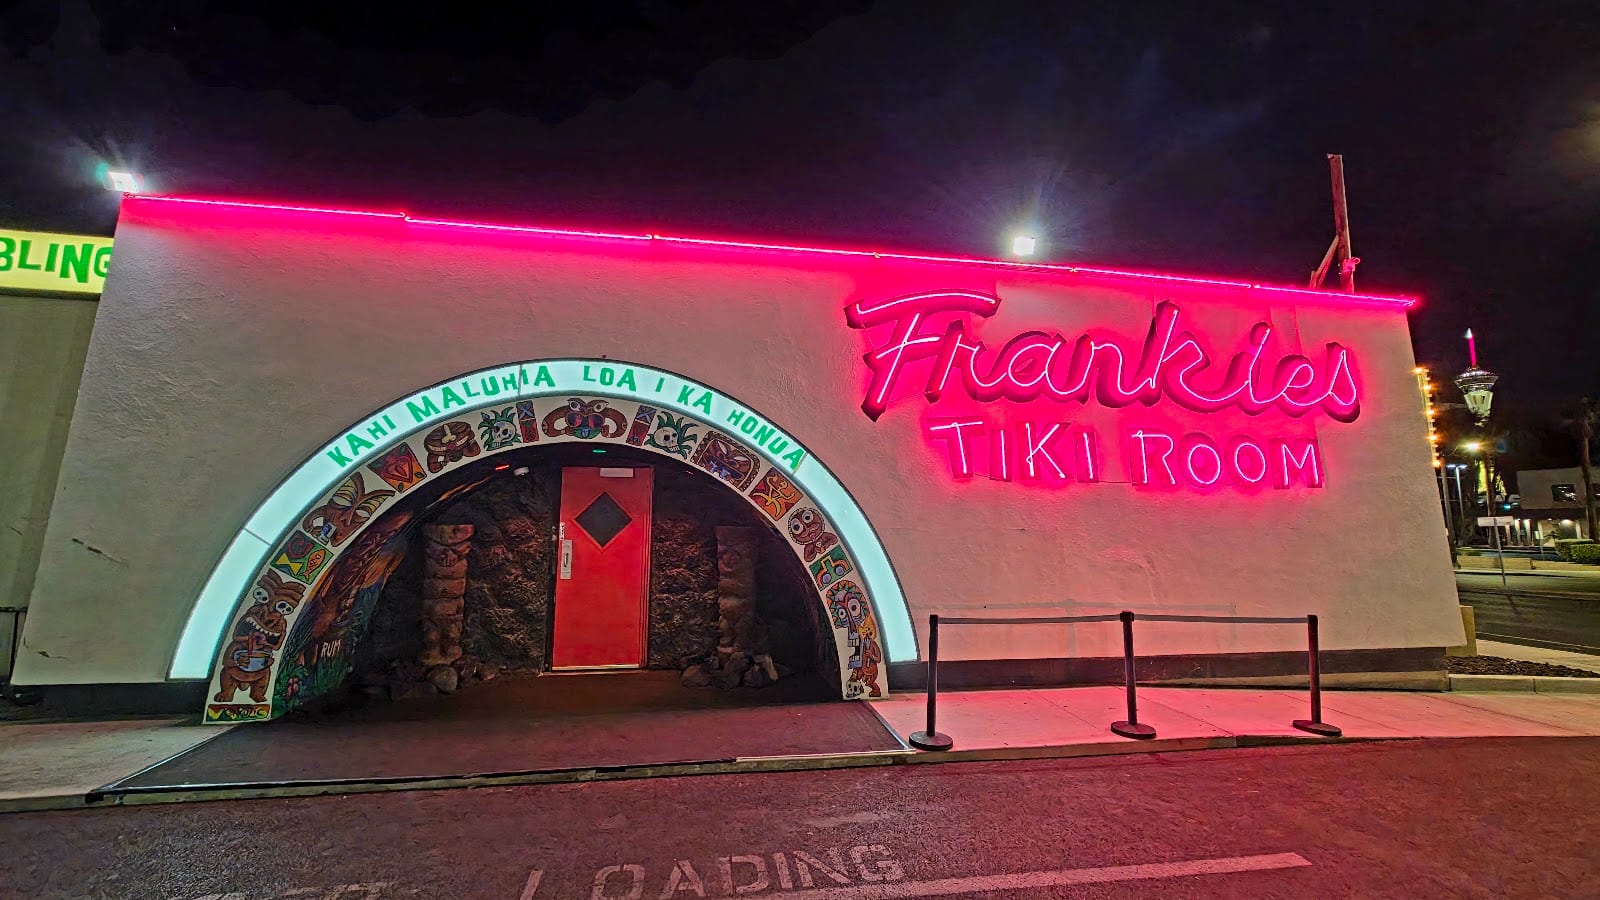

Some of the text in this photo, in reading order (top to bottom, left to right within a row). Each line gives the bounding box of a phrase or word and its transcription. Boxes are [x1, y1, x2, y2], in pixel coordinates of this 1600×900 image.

[326, 365, 805, 470] KAHI MALUHIA LOA I KA HONUA
[927, 417, 1324, 491] TIKI ROOM
[320, 640, 342, 658] RUM
